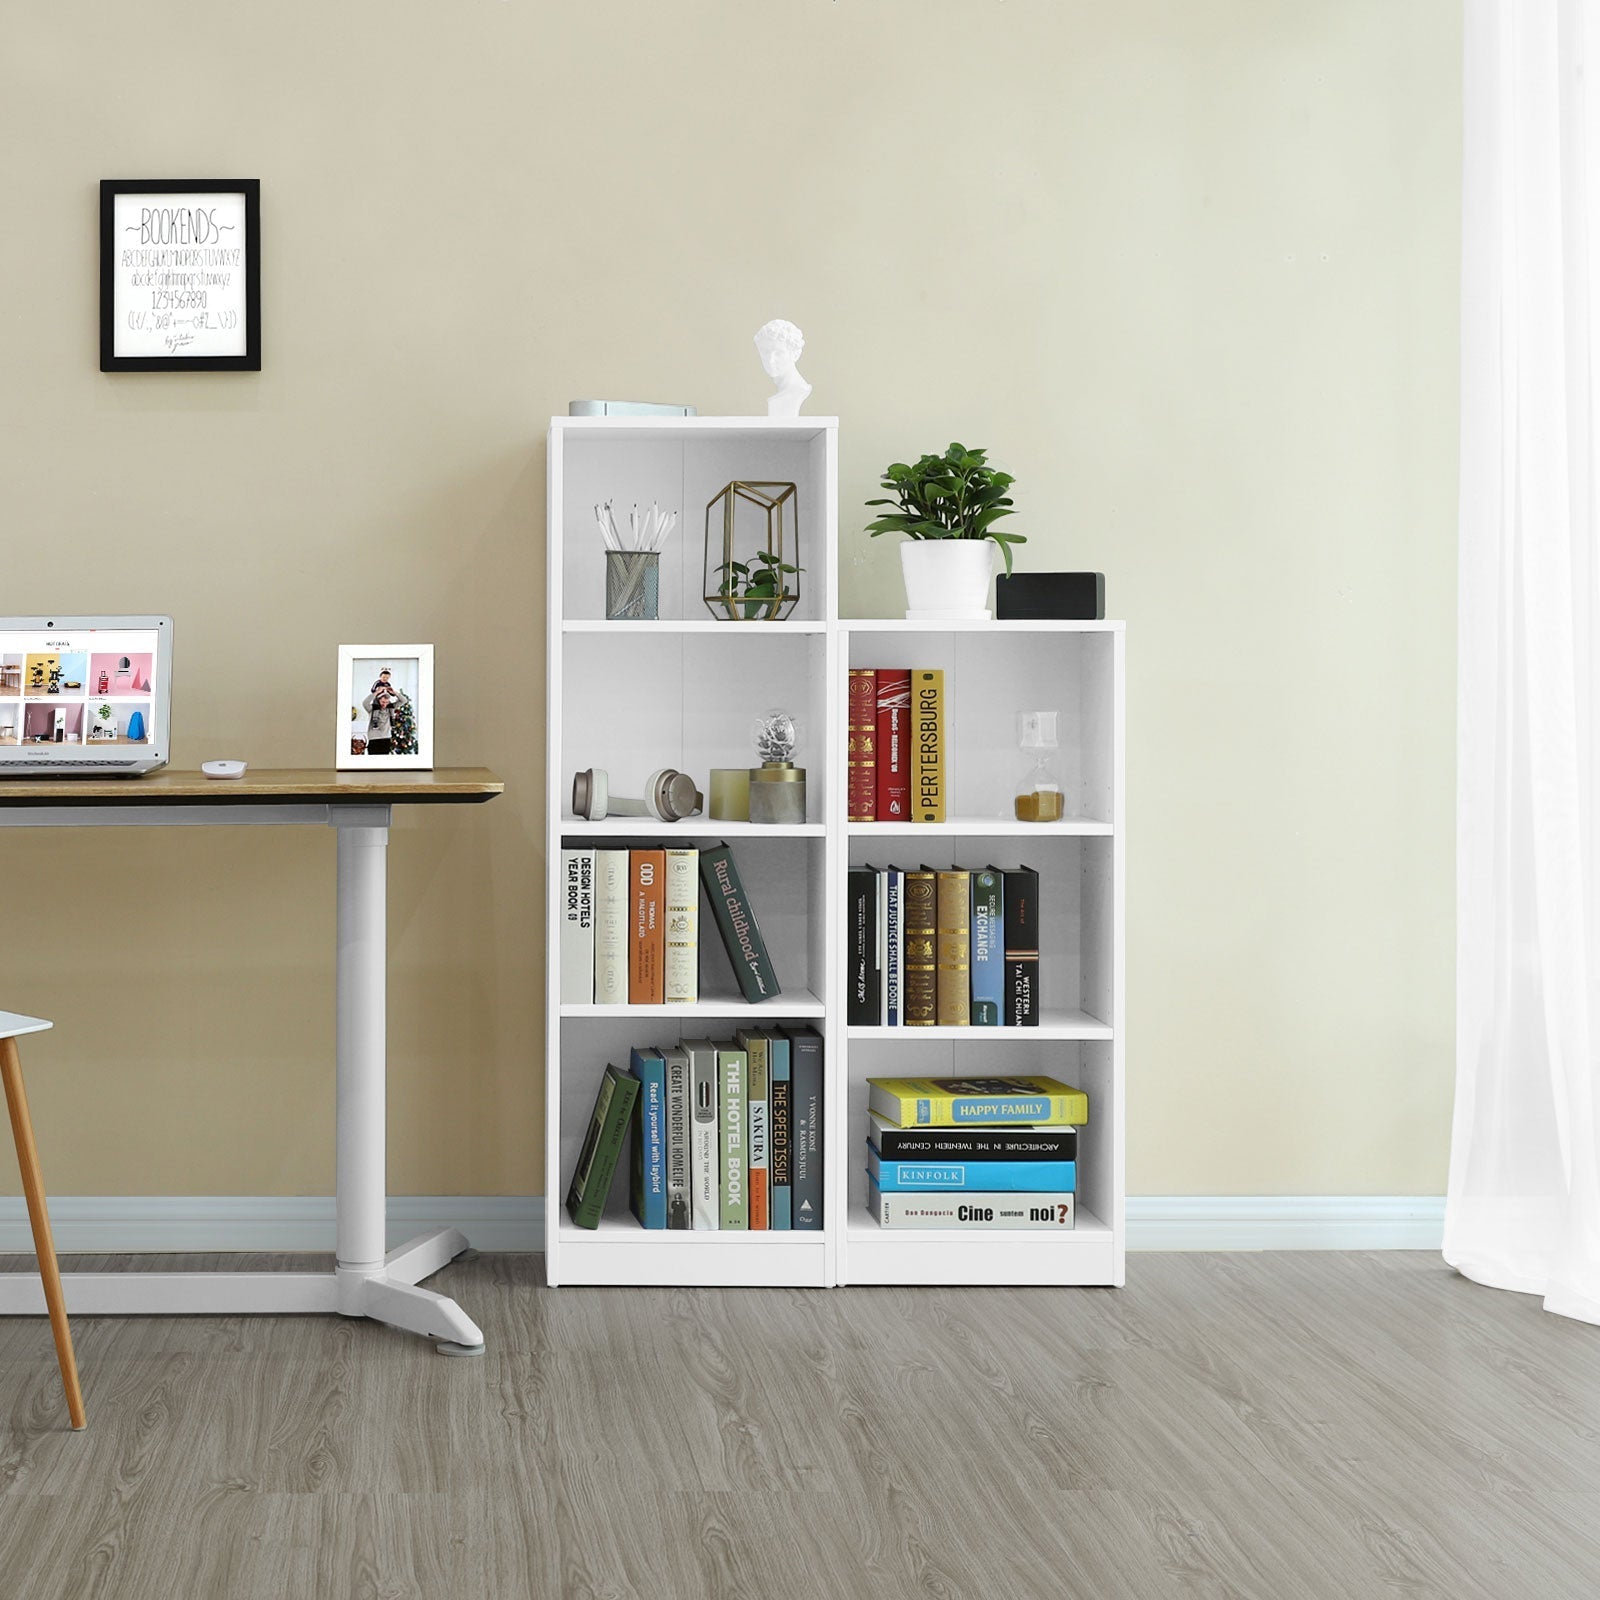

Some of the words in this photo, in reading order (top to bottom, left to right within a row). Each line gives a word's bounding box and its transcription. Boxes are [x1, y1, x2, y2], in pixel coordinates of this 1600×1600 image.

[152, 290, 207, 309] 1234567890
[920, 690, 938, 808] PERTERSBURG
[568, 858, 578, 883] YEAR
[581, 858, 591, 889] DESIGN
[640, 864, 653, 886] ODD
[713, 859, 736, 896] Rural
[568, 885, 578, 910] BOOK
[581, 892, 591, 928] HOTELS
[889, 886, 897, 907] THAT
[722, 897, 759, 962] childhood
[889, 908, 897, 943] JUSTICE
[977, 906, 988, 961] EXCHANGE
[889, 944, 897, 971] SHALL
[889, 974, 897, 984] BE
[889, 986, 897, 1010] DONE
[650, 1082, 659, 1101] Read
[672, 1065, 682, 1093] CREATE
[727, 1060, 740, 1094] THE
[650, 1102, 659, 1111] it
[774, 1085, 786, 1106] THE
[960, 1104, 998, 1116] HAPPY
[1001, 1104, 1042, 1115] FAMILY
[649, 1112, 660, 1144] yourself
[672, 1097, 683, 1145] WONDERFUL
[727, 1098, 740, 1153] HOTEL
[753, 1106, 764, 1162] SAKURA
[774, 1110, 786, 1144] SPEED
[651, 1146, 660, 1162] with
[672, 1148, 684, 1187] HOMELIFE
[774, 1149, 787, 1183] ISSUE
[650, 1164, 661, 1193] laybird
[728, 1158, 741, 1206] BOOK
[902, 1171, 959, 1180] KINFOLK
[958, 1205, 993, 1222] Cine
